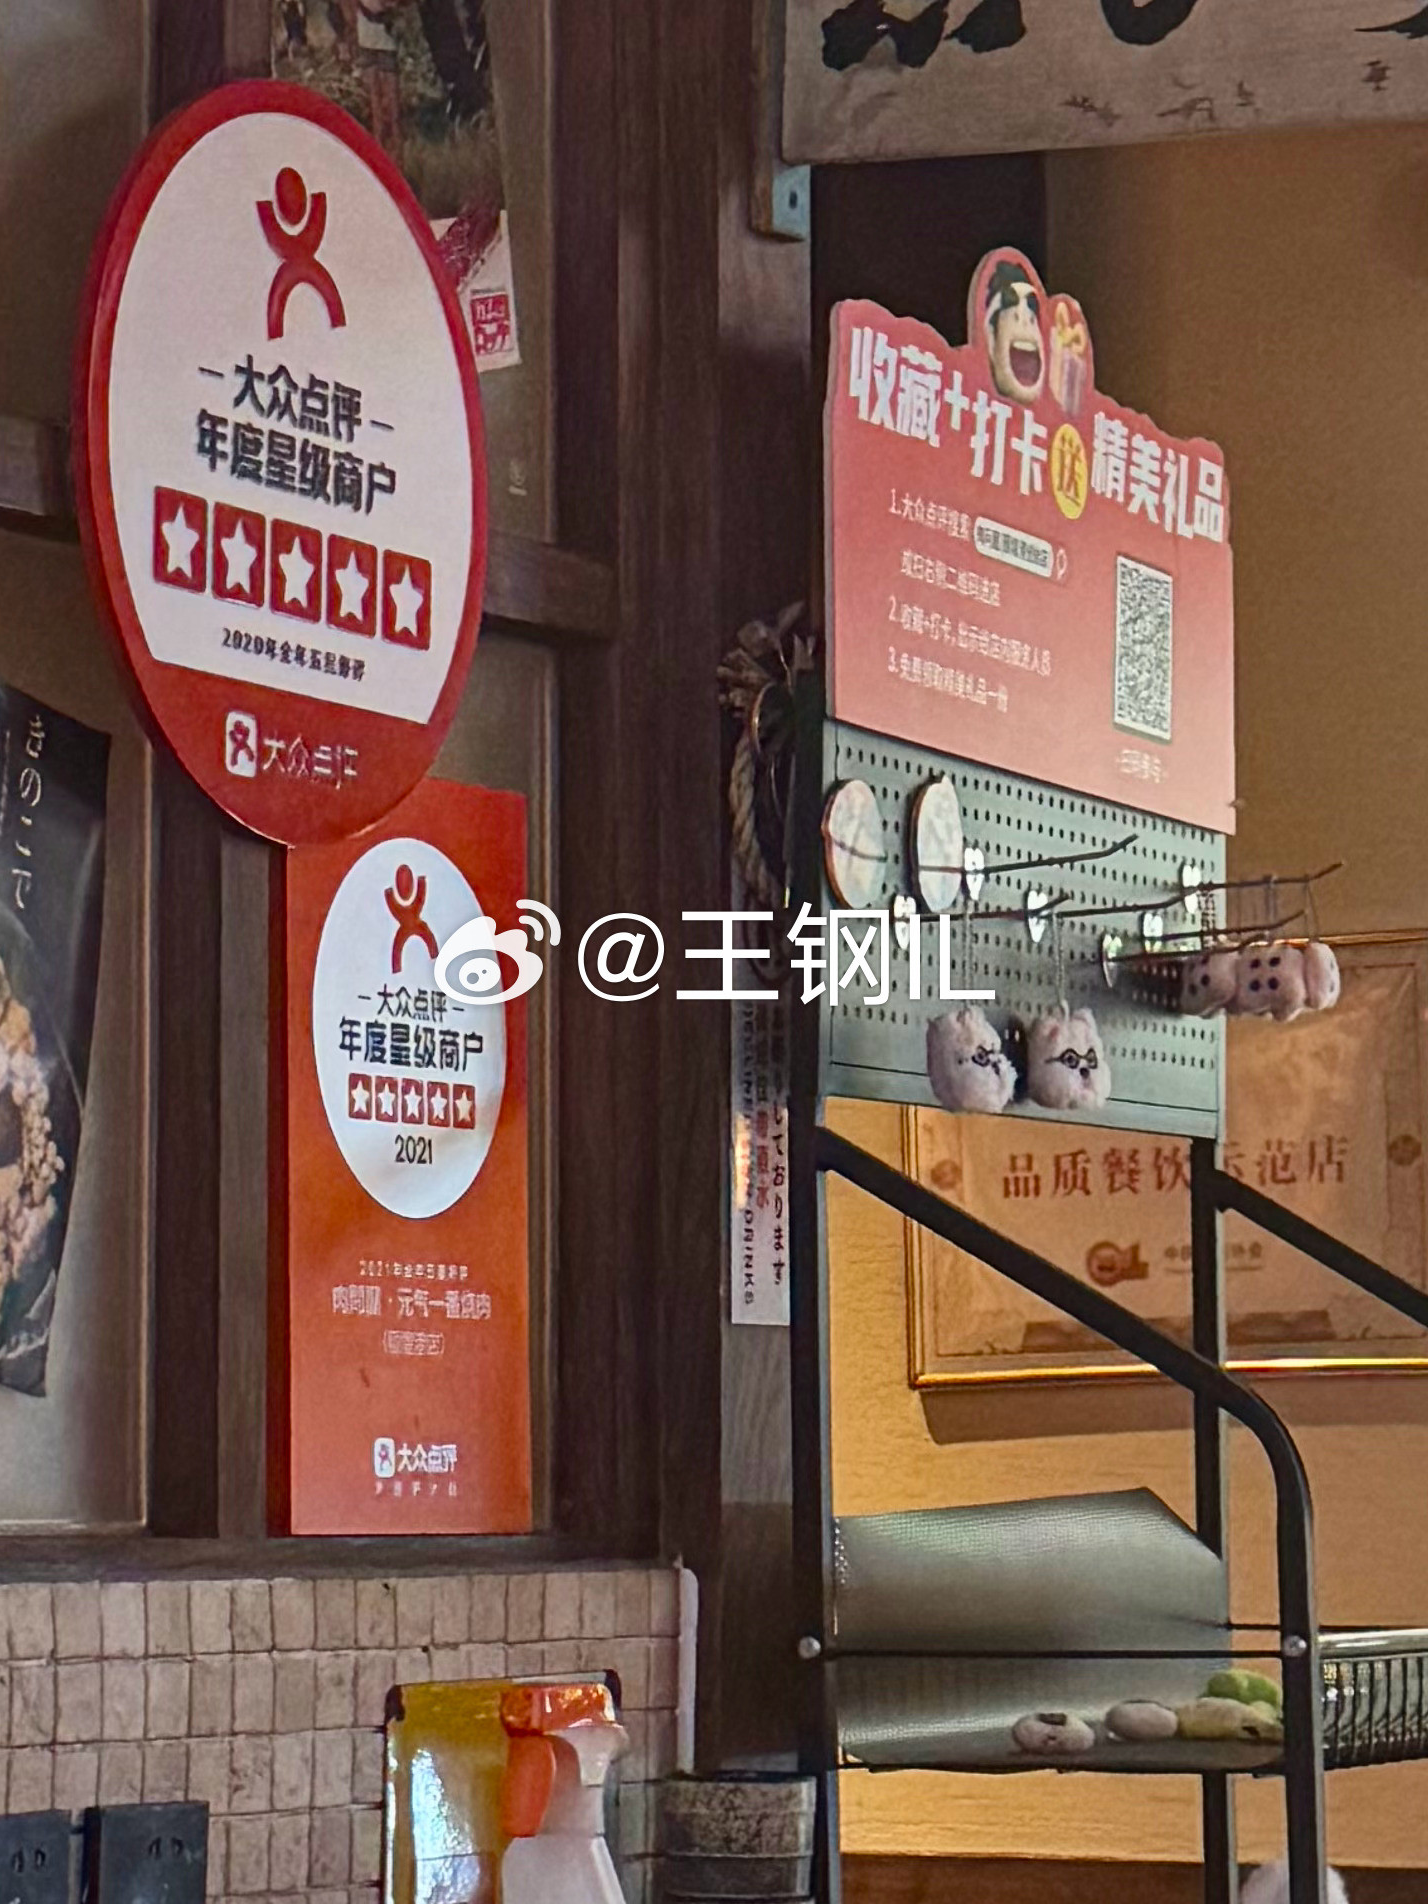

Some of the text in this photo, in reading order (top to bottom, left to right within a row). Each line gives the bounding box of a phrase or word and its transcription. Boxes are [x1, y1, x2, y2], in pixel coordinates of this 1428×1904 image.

[232, 353, 363, 444] 大众点评
[195, 408, 397, 516] 年度星级商户
[11, 714, 45, 909] きのこで
[377, 983, 448, 1023] 大众点评
[338, 1015, 484, 1072] 年度星级商户
[394, 1134, 433, 1165] 2021
[396, 1442, 458, 1473] 大众点评
